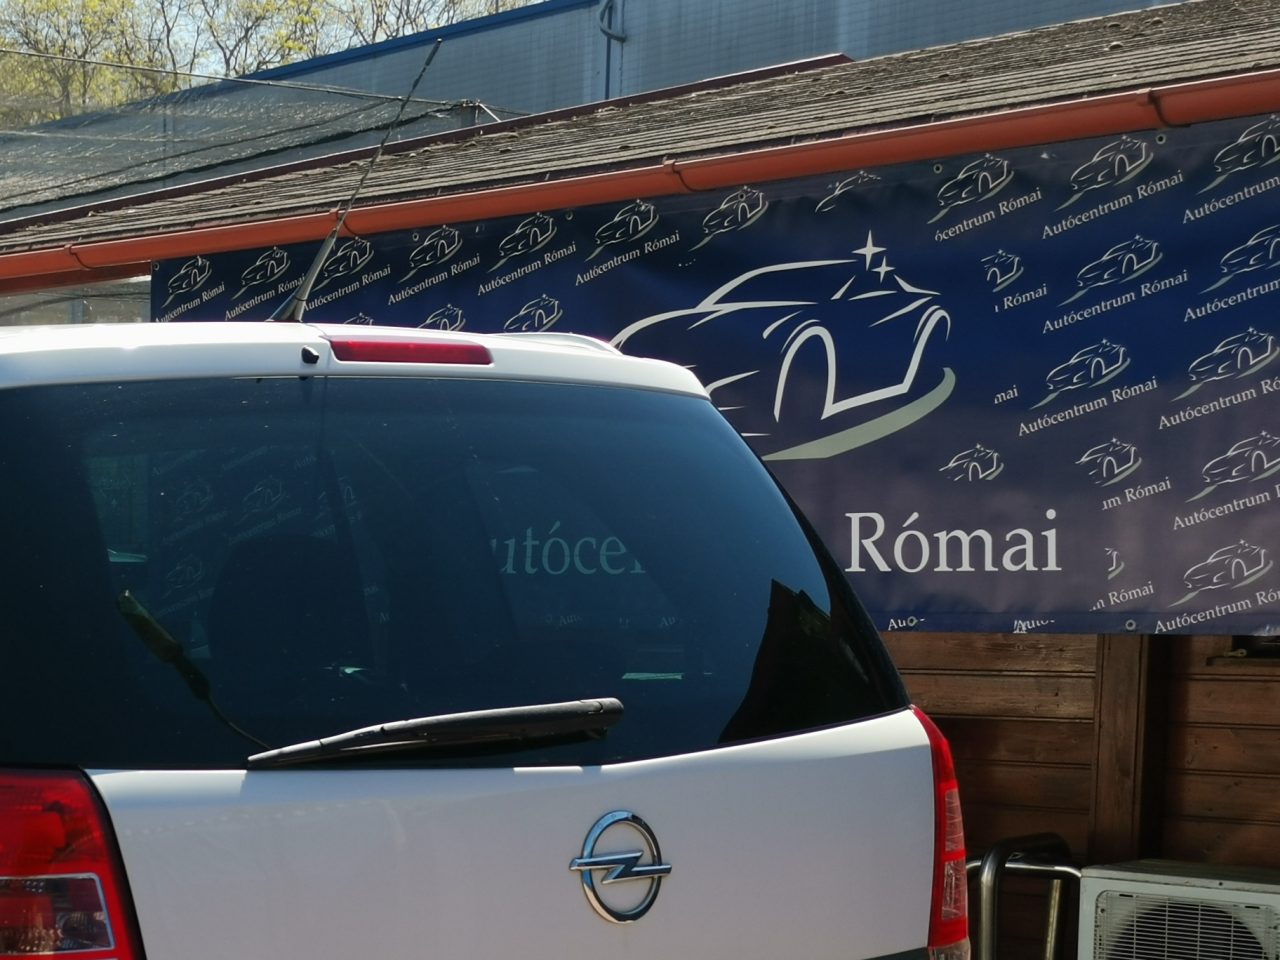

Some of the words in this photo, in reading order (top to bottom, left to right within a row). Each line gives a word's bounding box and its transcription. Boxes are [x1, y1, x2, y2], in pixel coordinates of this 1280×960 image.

[998, 186, 1043, 216] Római
[1042, 193, 1133, 239] Autócentrum
[1136, 169, 1184, 199] Római
[361, 265, 391, 287] Római
[477, 259, 542, 296] Autócentrum
[543, 241, 577, 264] Római
[575, 248, 641, 286] Autócentrum
[643, 230, 681, 253] Római
[201, 281, 225, 302] Római
[388, 271, 449, 305] Autócentrum
[450, 252, 481, 275] Római
[1003, 283, 1048, 310] Római
[224, 289, 276, 322] Autócentrum
[1042, 291, 1136, 334] Autócentrum
[1140, 269, 1189, 297] Római
[1018, 397, 1107, 437] Autócentrum
[1110, 375, 1159, 402] Római
[1158, 387, 1257, 430] Autócentrum
[1124, 477, 1171, 502] Római
[1173, 490, 1270, 530] Autócentrum
[844, 508, 1063, 574] Római
[1107, 580, 1154, 605] Római
[1154, 600, 1252, 634] Autócentrum
